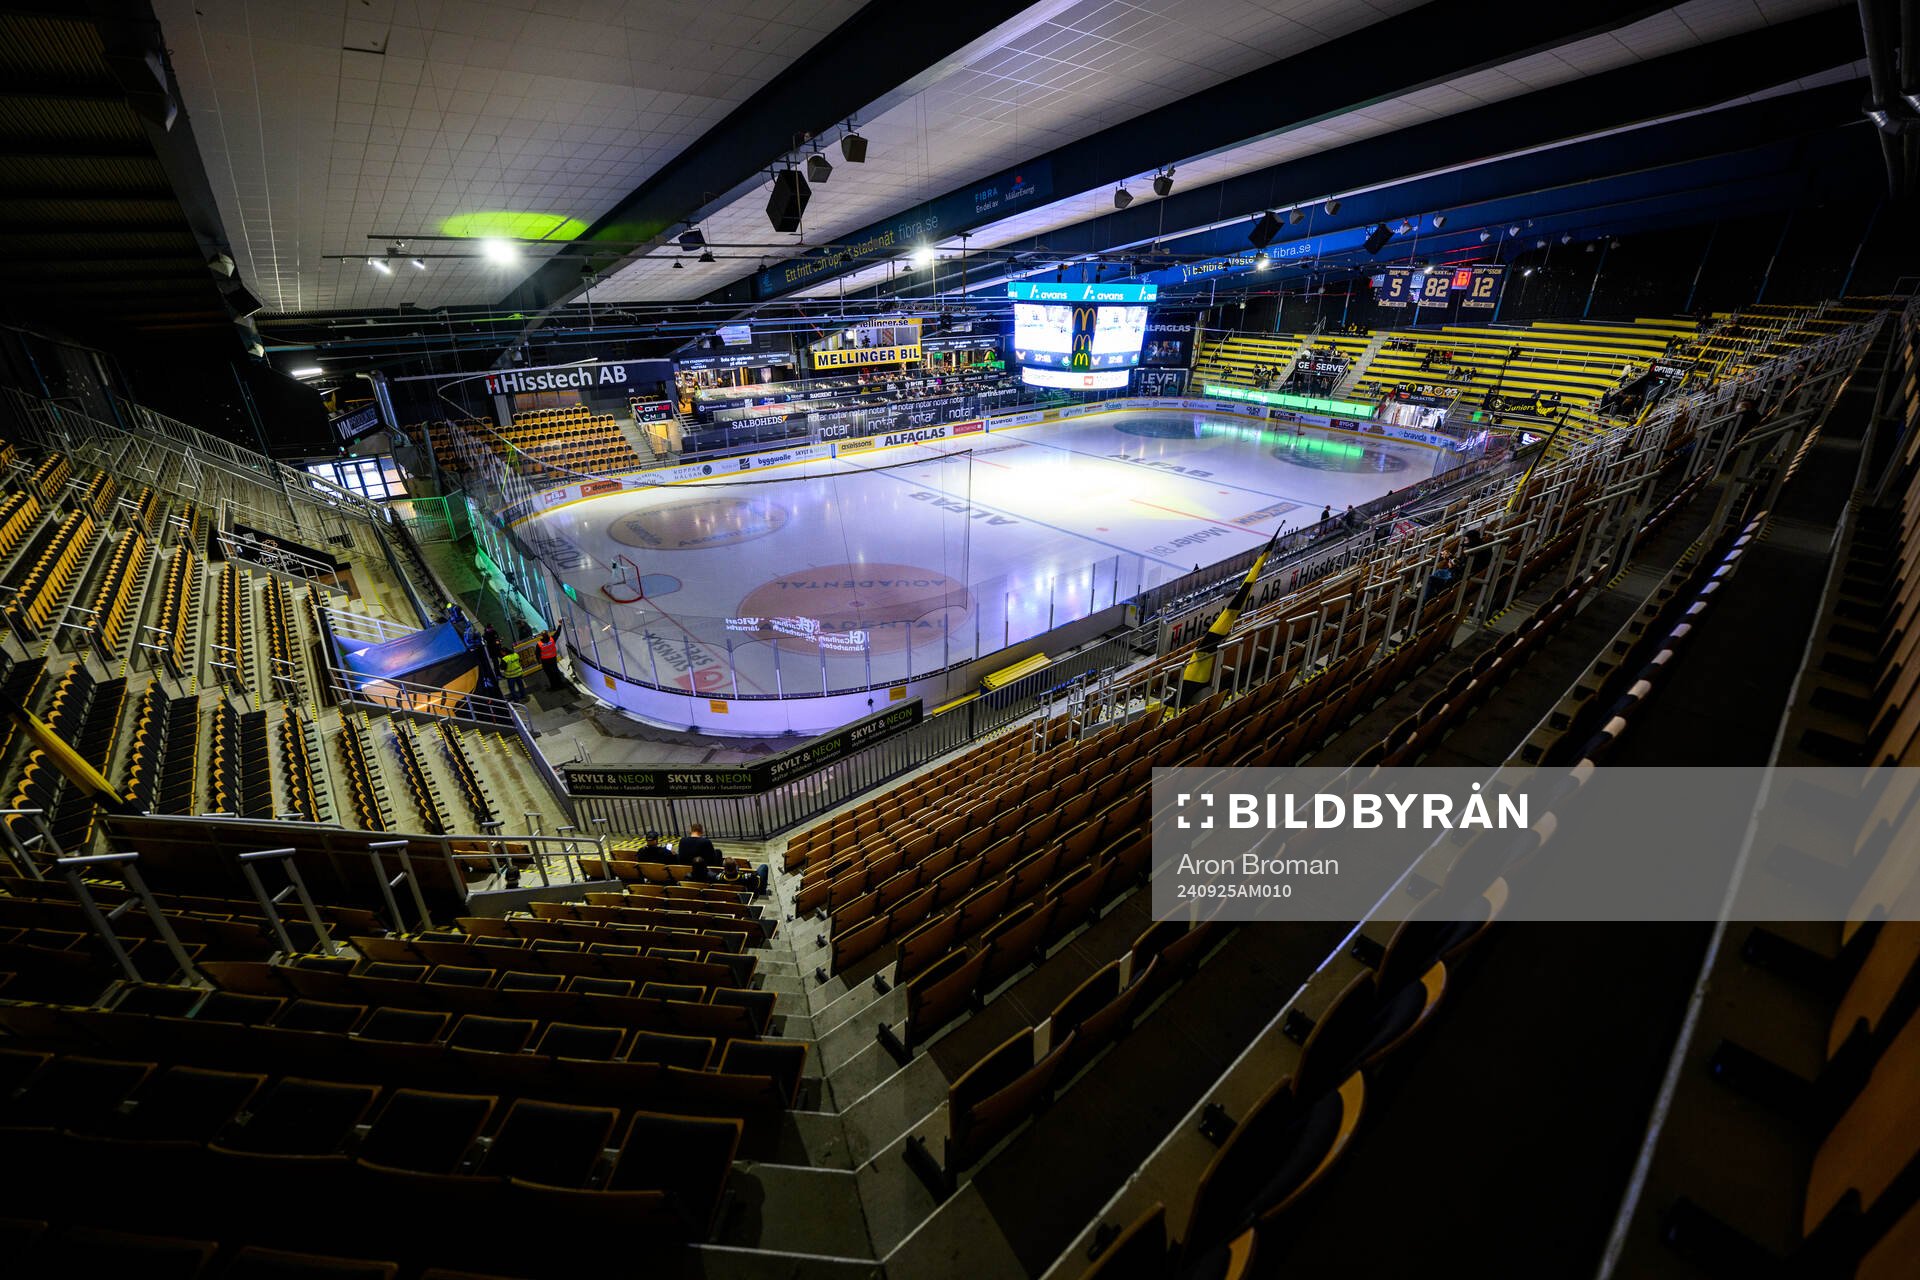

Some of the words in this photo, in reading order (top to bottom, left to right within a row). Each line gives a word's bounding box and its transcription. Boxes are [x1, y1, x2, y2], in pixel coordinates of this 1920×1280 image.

[975, 187, 998, 202] FIBRA
[785, 268, 797, 283] Ett
[899, 214, 938, 241] fibra.se
[1273, 242, 1311, 259] fibra.se
[1040, 291, 1067, 300] avans
[1390, 279, 1403, 297] 5
[1425, 278, 1449, 297] 82
[1472, 277, 1494, 297] 12
[1097, 292, 1124, 301] avans
[1144, 324, 1191, 332] ALFAGLAS
[818, 349, 896, 366] MELLINGER
[901, 348, 919, 360] BIL
[500, 367, 592, 393] Hisstech
[600, 365, 627, 385] AB
[829, 411, 848, 420] notar
[868, 406, 887, 415] notar
[898, 402, 915, 411] notar
[915, 400, 932, 408] notar
[933, 398, 949, 406] notar
[950, 396, 965, 404] notar
[949, 406, 974, 419] notar
[732, 416, 783, 430] SALBOHEDS
[819, 423, 850, 438] notar
[885, 427, 945, 446] ALFAGLAS
[1403, 430, 1427, 441] bravida
[776, 579, 947, 589] AQUADENTAL
[1260, 579, 1281, 606] AB
[851, 725, 877, 741] SKYLT
[878, 719, 886, 729] &
[886, 707, 913, 726] NEON
[770, 756, 801, 775] SKYLT
[803, 752, 811, 762] &
[812, 738, 841, 759] NEON
[570, 773, 605, 783] SKYLT
[607, 774, 617, 784] &
[619, 774, 654, 783] NEON
[667, 774, 701, 783] SKYLT
[705, 774, 714, 783] &
[716, 773, 751, 783] NEON
